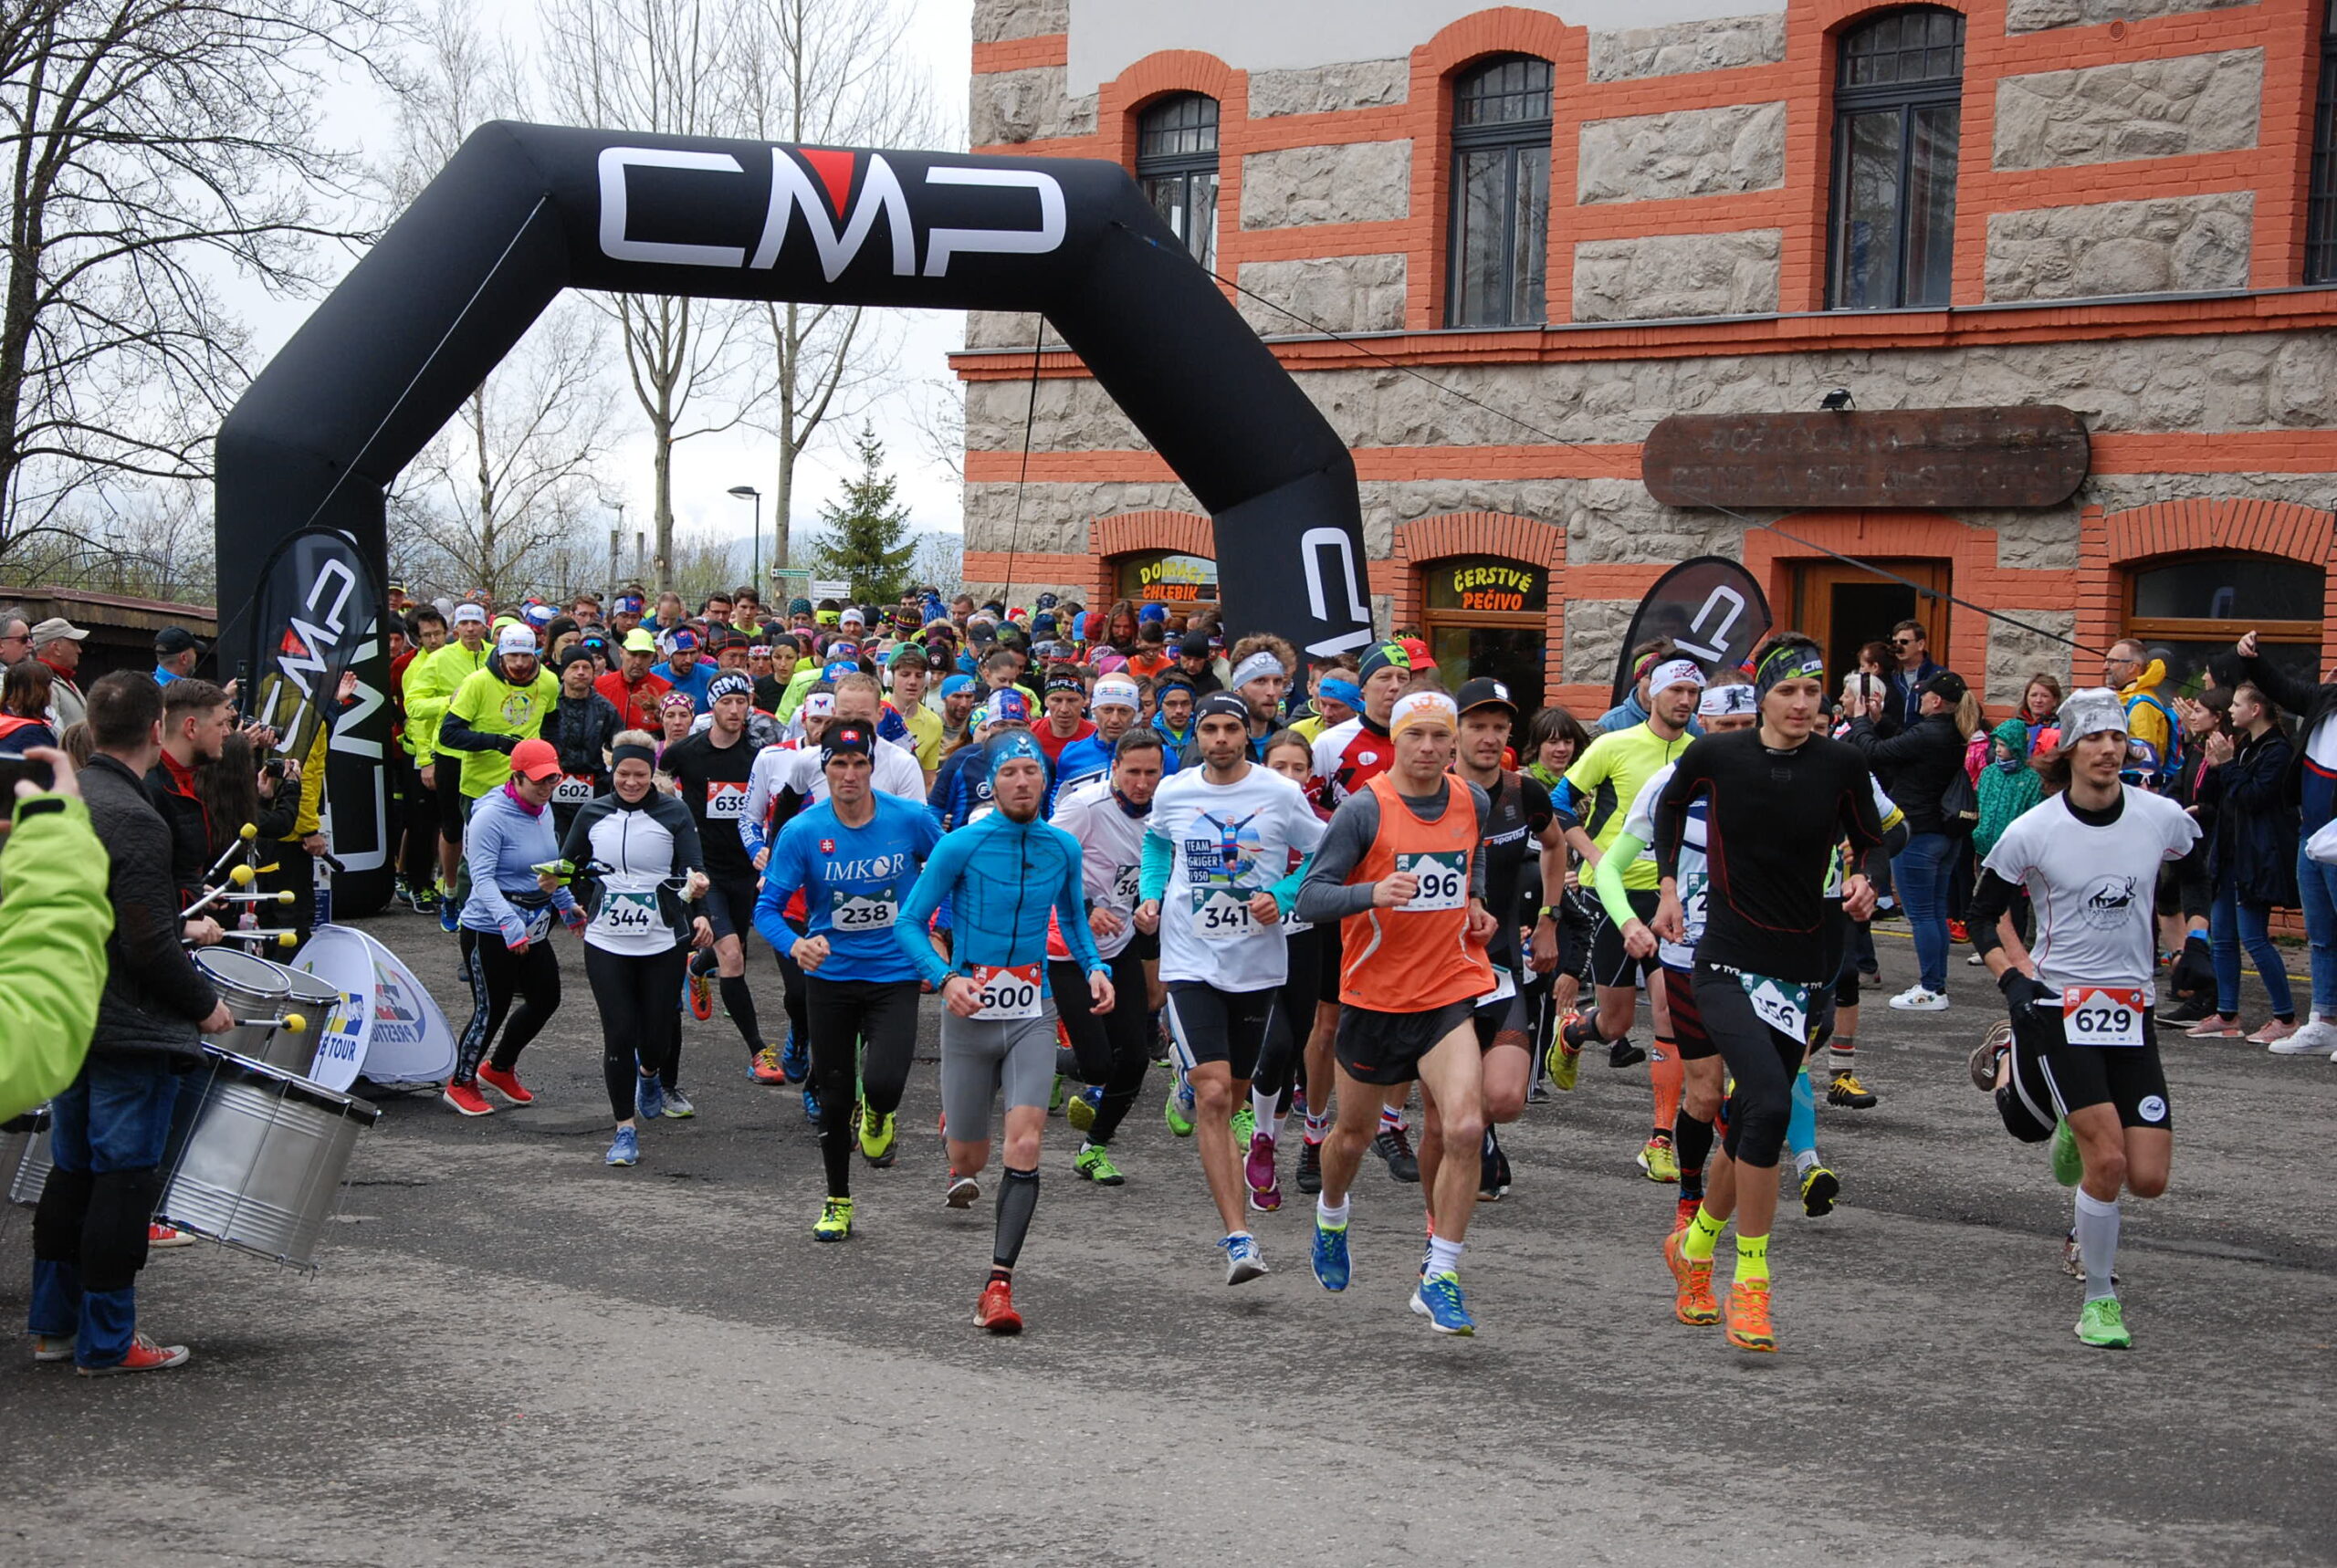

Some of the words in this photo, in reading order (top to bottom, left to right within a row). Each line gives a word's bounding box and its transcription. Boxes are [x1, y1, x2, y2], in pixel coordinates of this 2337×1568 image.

[598, 146, 1066, 283] CMP
[1453, 567, 1533, 593] ČERSTVÉ
[1142, 582, 1198, 601] CHLEBÍK
[1462, 589, 1523, 611] PEČIVO
[261, 558, 356, 754] CMP
[559, 784, 589, 797] 602
[1187, 841, 1210, 852] TEAM
[823, 853, 904, 882] IMKOR
[1188, 856, 1219, 867] GRIGER
[1189, 871, 1209, 882] 1950
[609, 909, 649, 927] 344
[842, 904, 888, 925] 238
[1204, 906, 1249, 929] 341
[980, 985, 1034, 1009] 600
[2075, 1008, 2132, 1033] 629
[328, 1037, 356, 1061] TOUR
